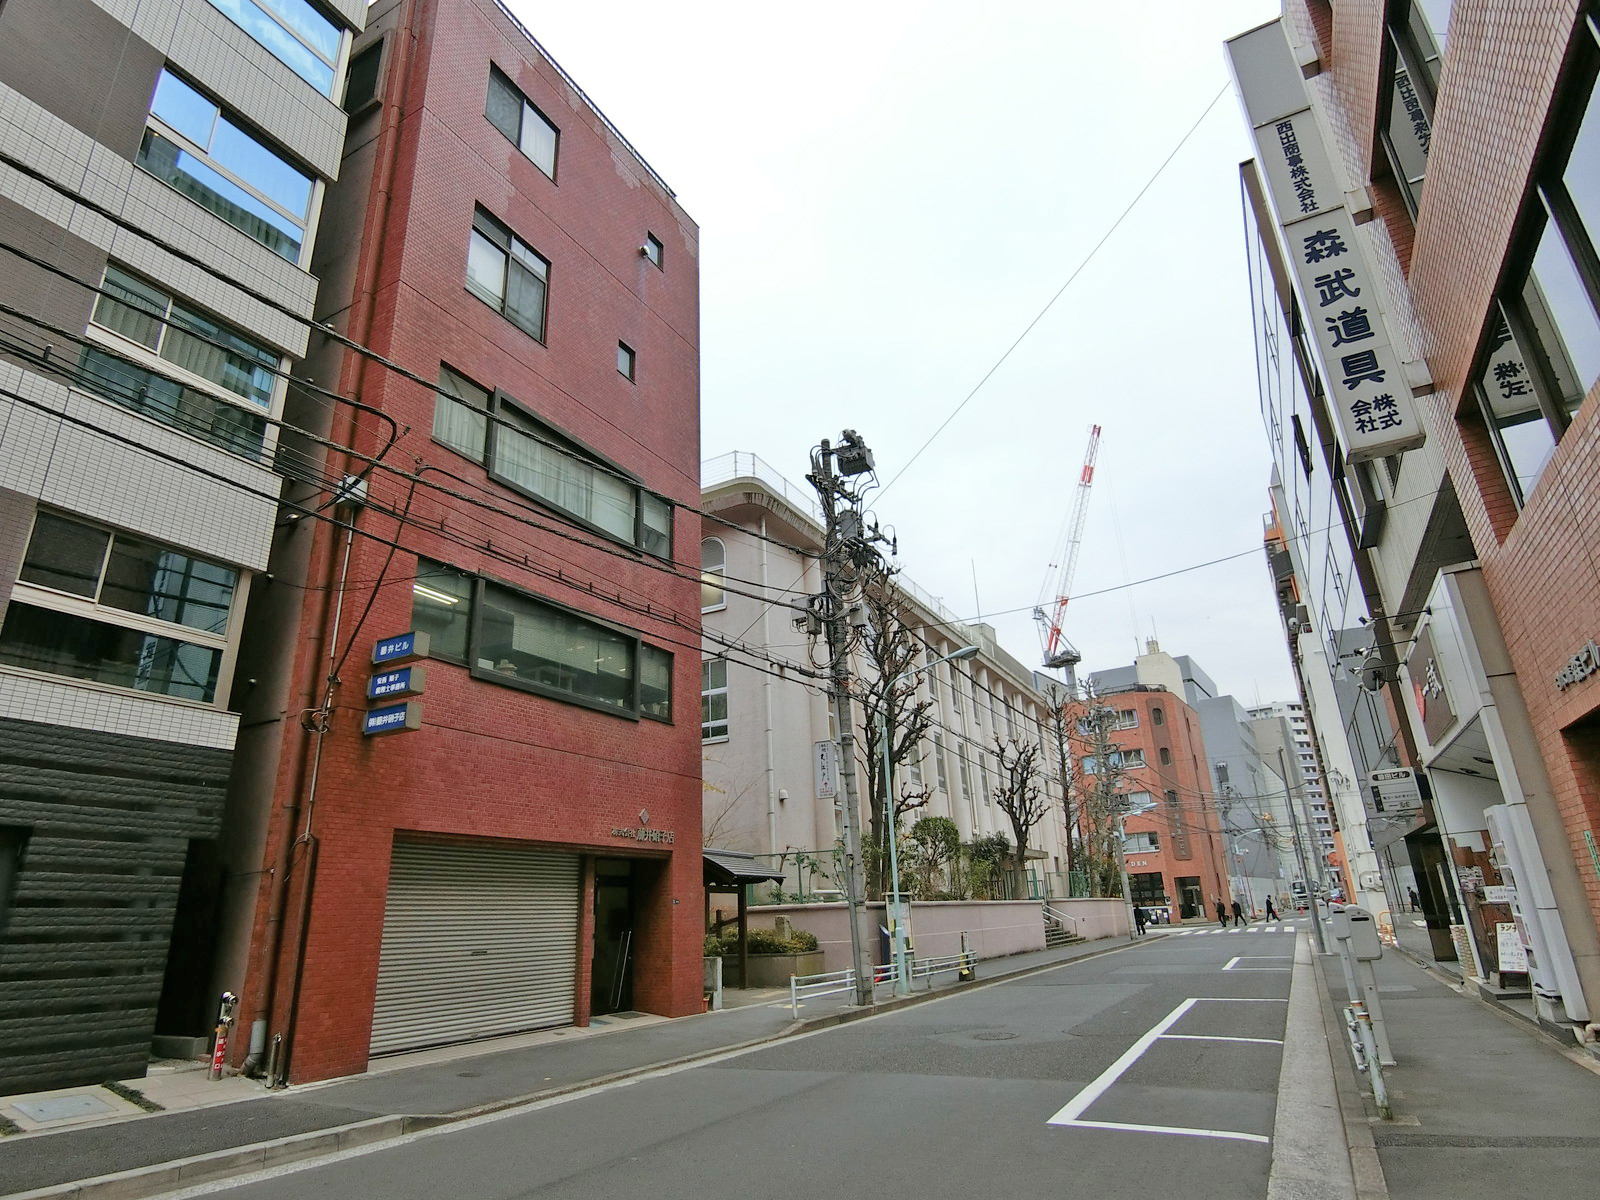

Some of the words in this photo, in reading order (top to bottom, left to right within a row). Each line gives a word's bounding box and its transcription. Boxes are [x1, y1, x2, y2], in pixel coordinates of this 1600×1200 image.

[1275, 119, 1320, 214] 西出商事株式会社
[1303, 227, 1386, 391] 森武道具
[1125, 860, 1148, 868] DEN
